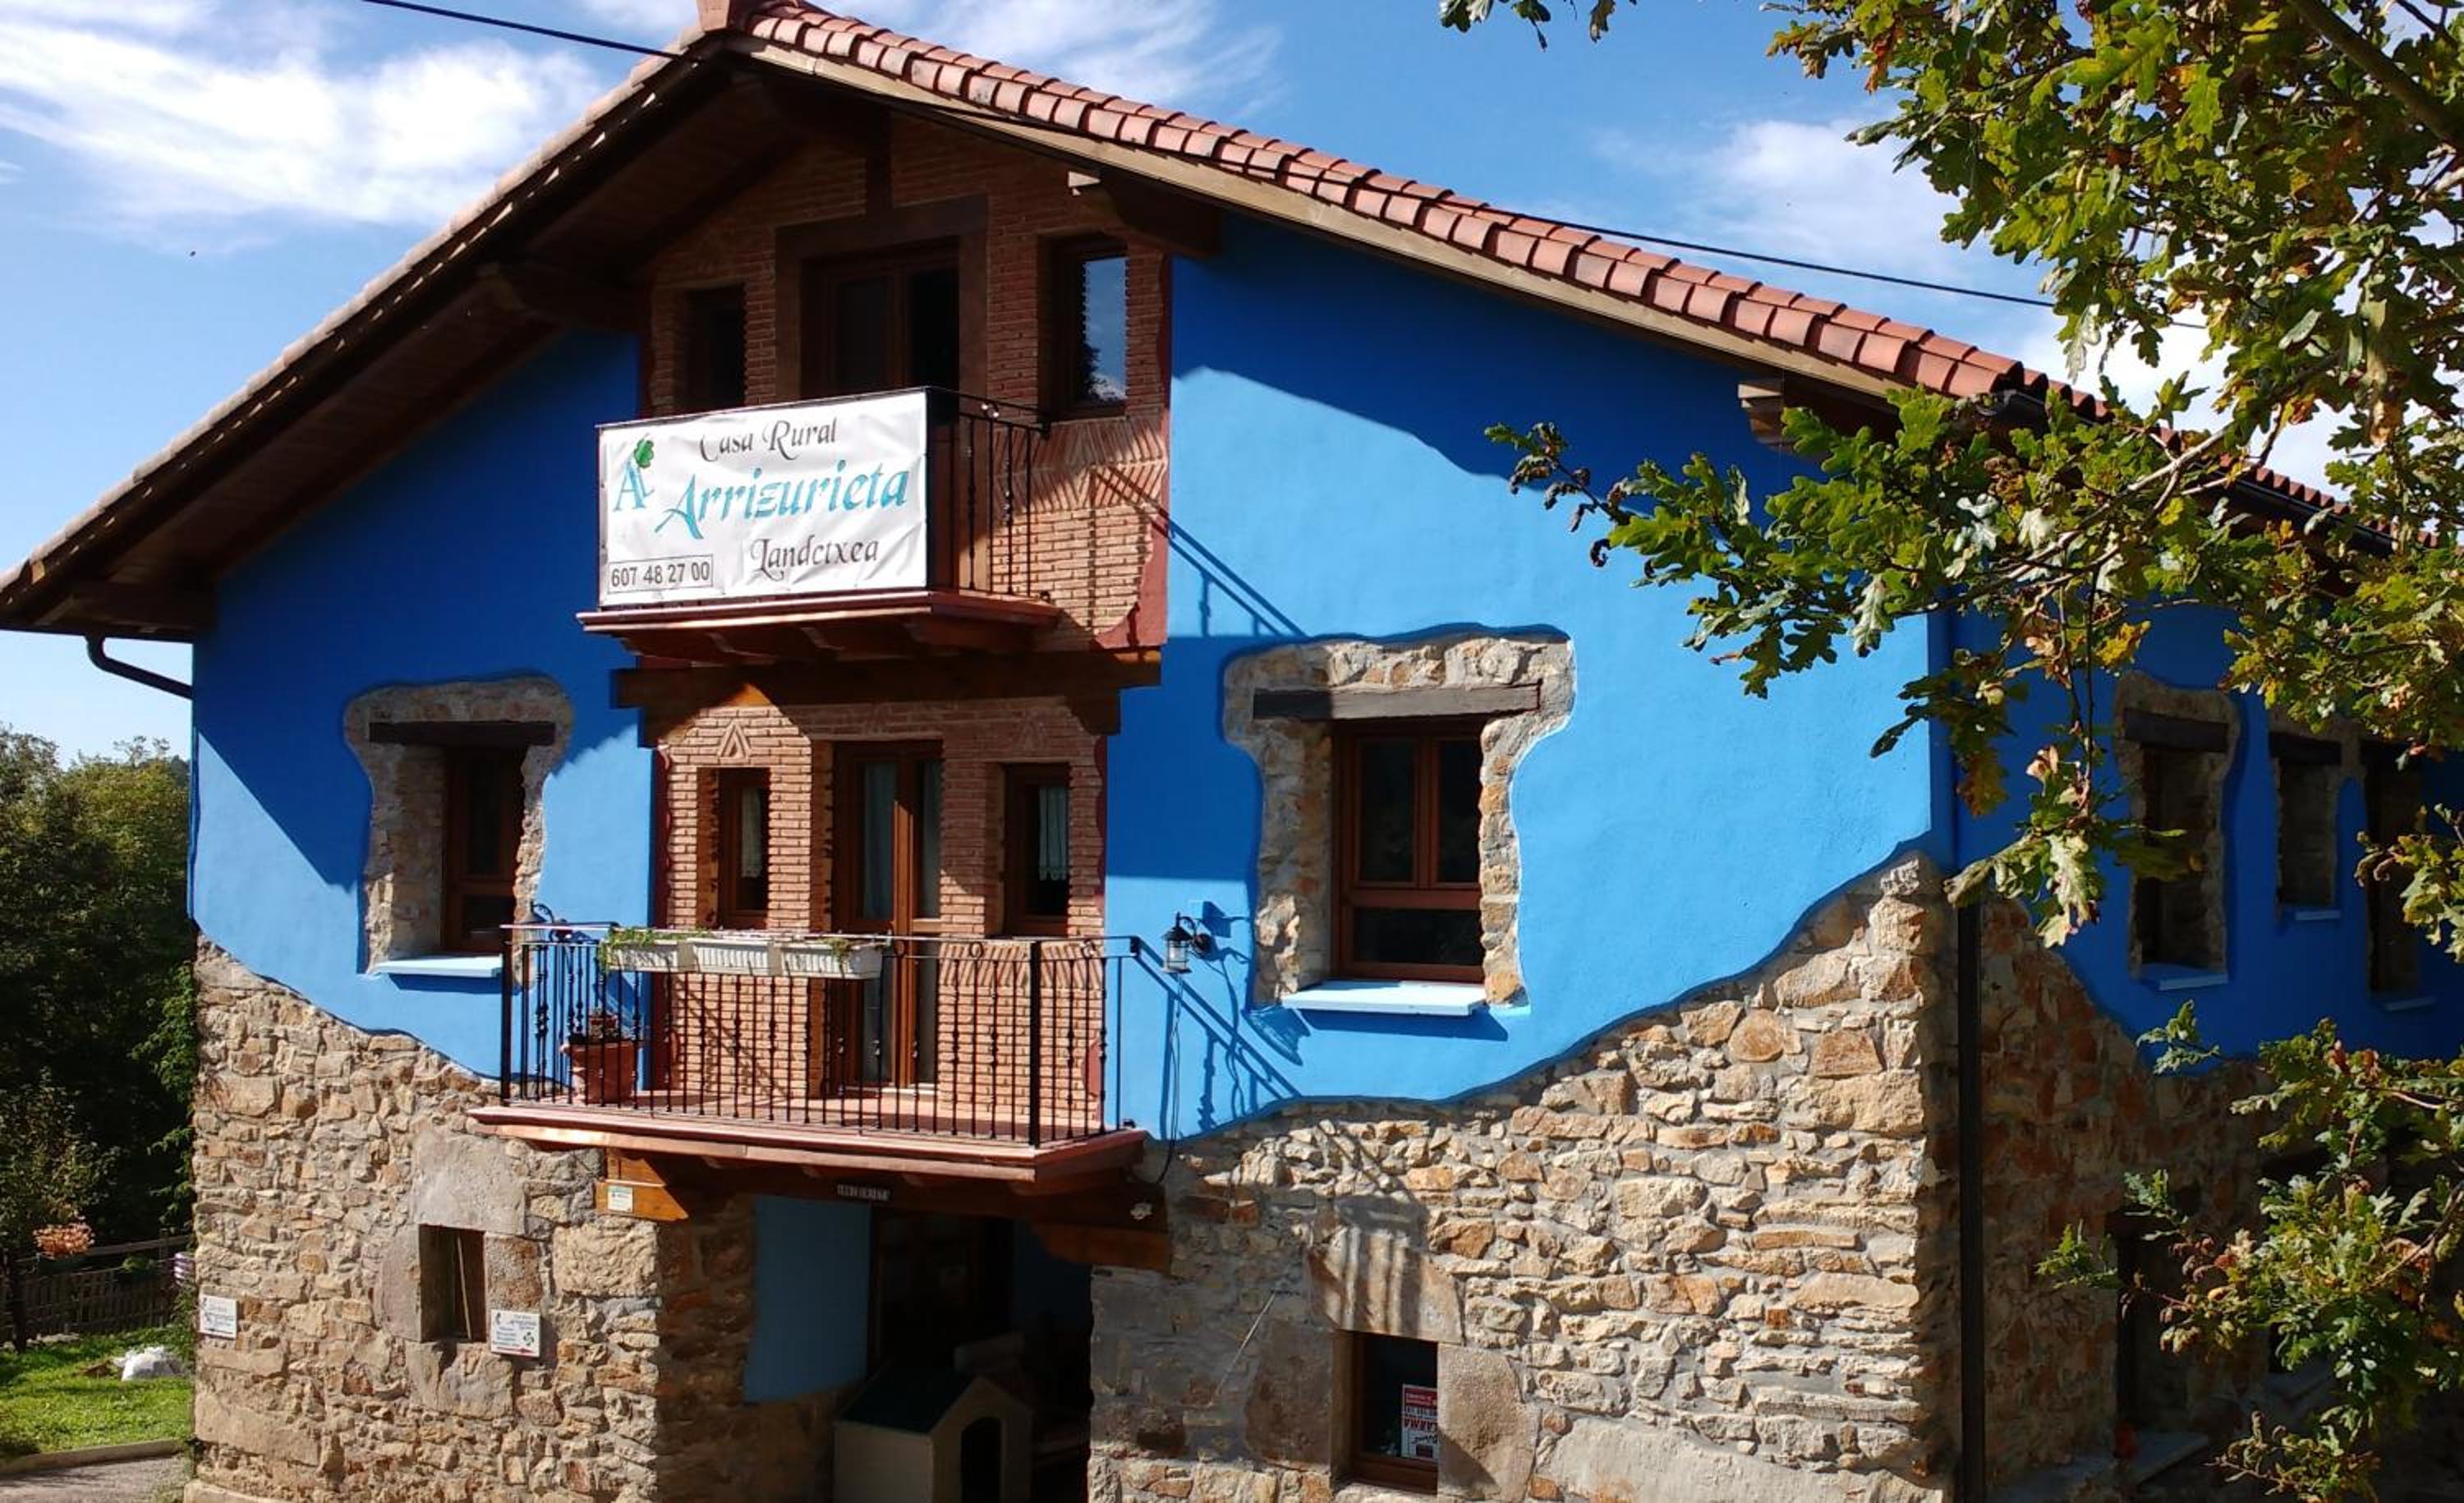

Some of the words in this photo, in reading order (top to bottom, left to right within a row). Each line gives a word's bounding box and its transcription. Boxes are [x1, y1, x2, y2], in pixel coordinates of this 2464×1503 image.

[700, 433, 753, 462] Casa
[762, 417, 837, 461] Rural
[655, 459, 910, 540] Arrizurieta
[611, 567, 637, 587] 607
[643, 565, 663, 585] 48
[668, 563, 686, 583] 27
[691, 561, 710, 581] 00
[750, 535, 879, 581] Landetxea
